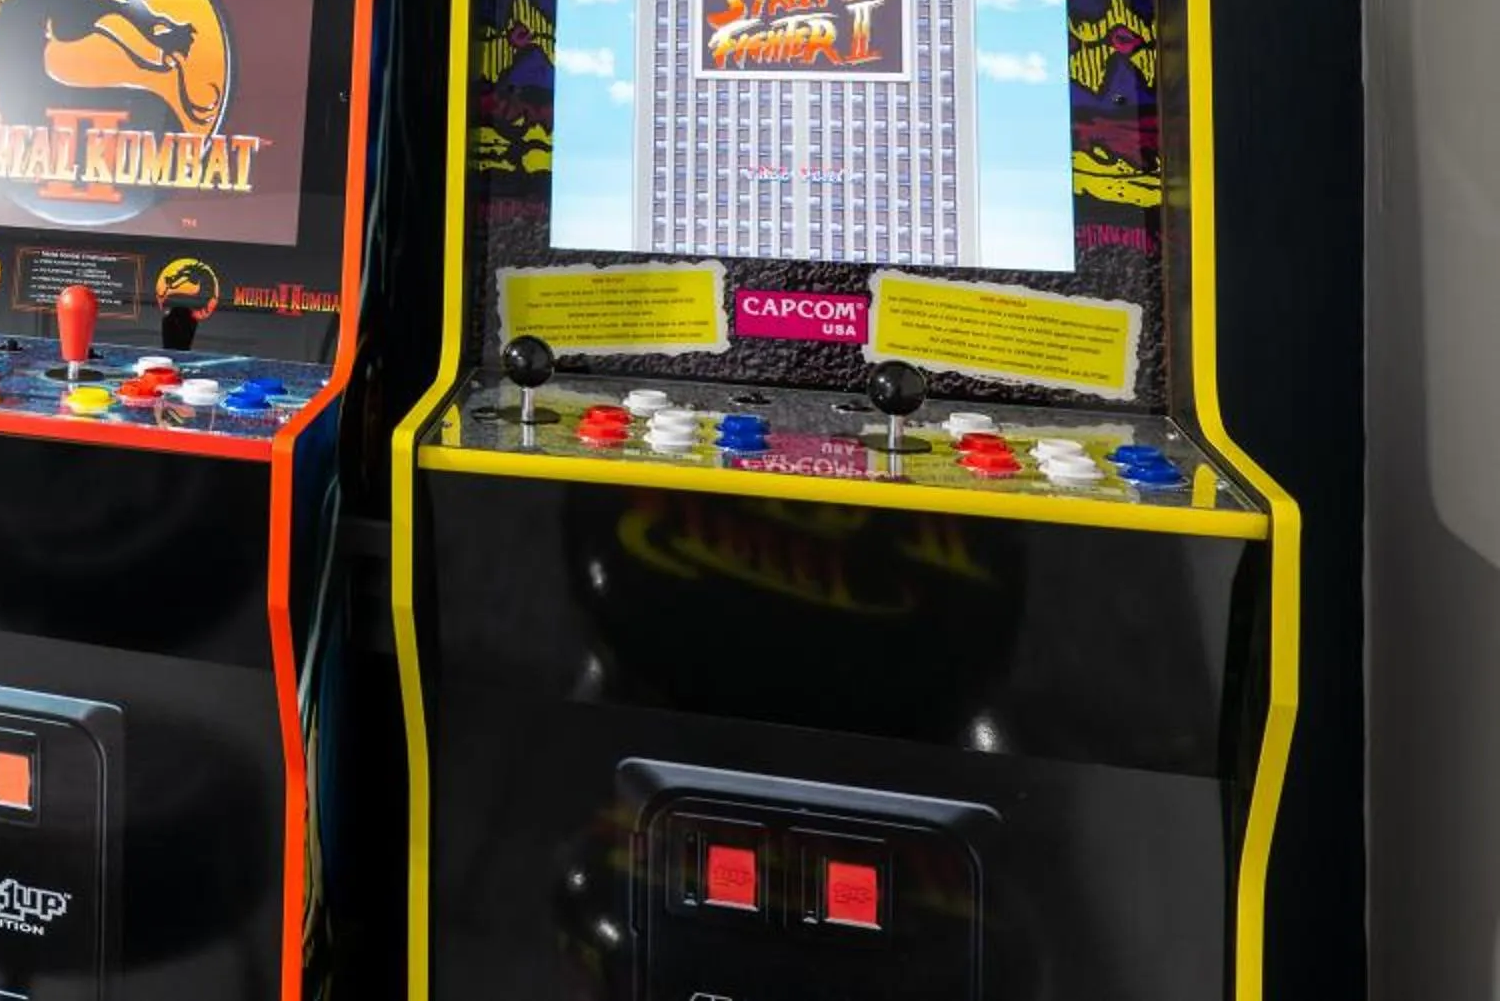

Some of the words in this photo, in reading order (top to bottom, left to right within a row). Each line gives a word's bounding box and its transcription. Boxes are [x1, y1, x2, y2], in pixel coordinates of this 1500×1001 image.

[844, 0, 885, 65] II
[37, 109, 131, 203] II
[82, 128, 259, 192] KOMBAT
[290, 288, 341, 312] KOMBA
[742, 296, 857, 321] CAPCOM
[822, 323, 856, 336] USA
